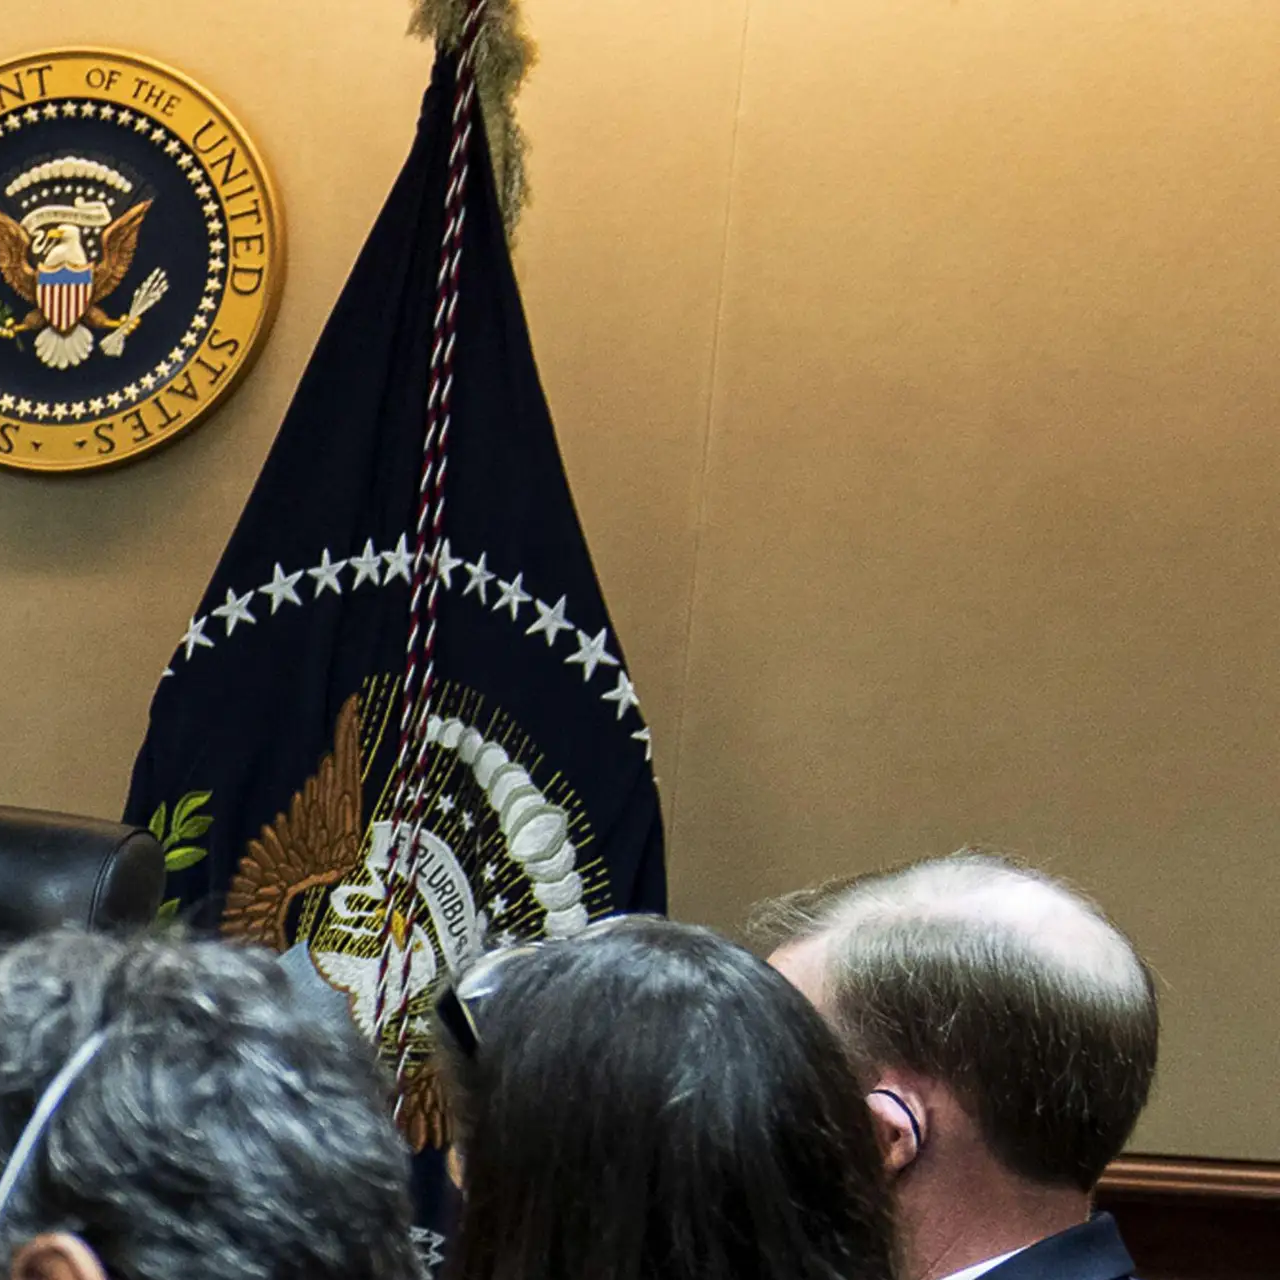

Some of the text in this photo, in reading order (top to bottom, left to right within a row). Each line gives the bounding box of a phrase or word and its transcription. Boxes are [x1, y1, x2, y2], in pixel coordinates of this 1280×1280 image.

[85, 67, 122, 92] OF
[133, 78, 182, 117] THE
[192, 121, 265, 297] UNITED
[92, 328, 240, 455] STATES
[408, 844, 469, 956] PLURIBUS
